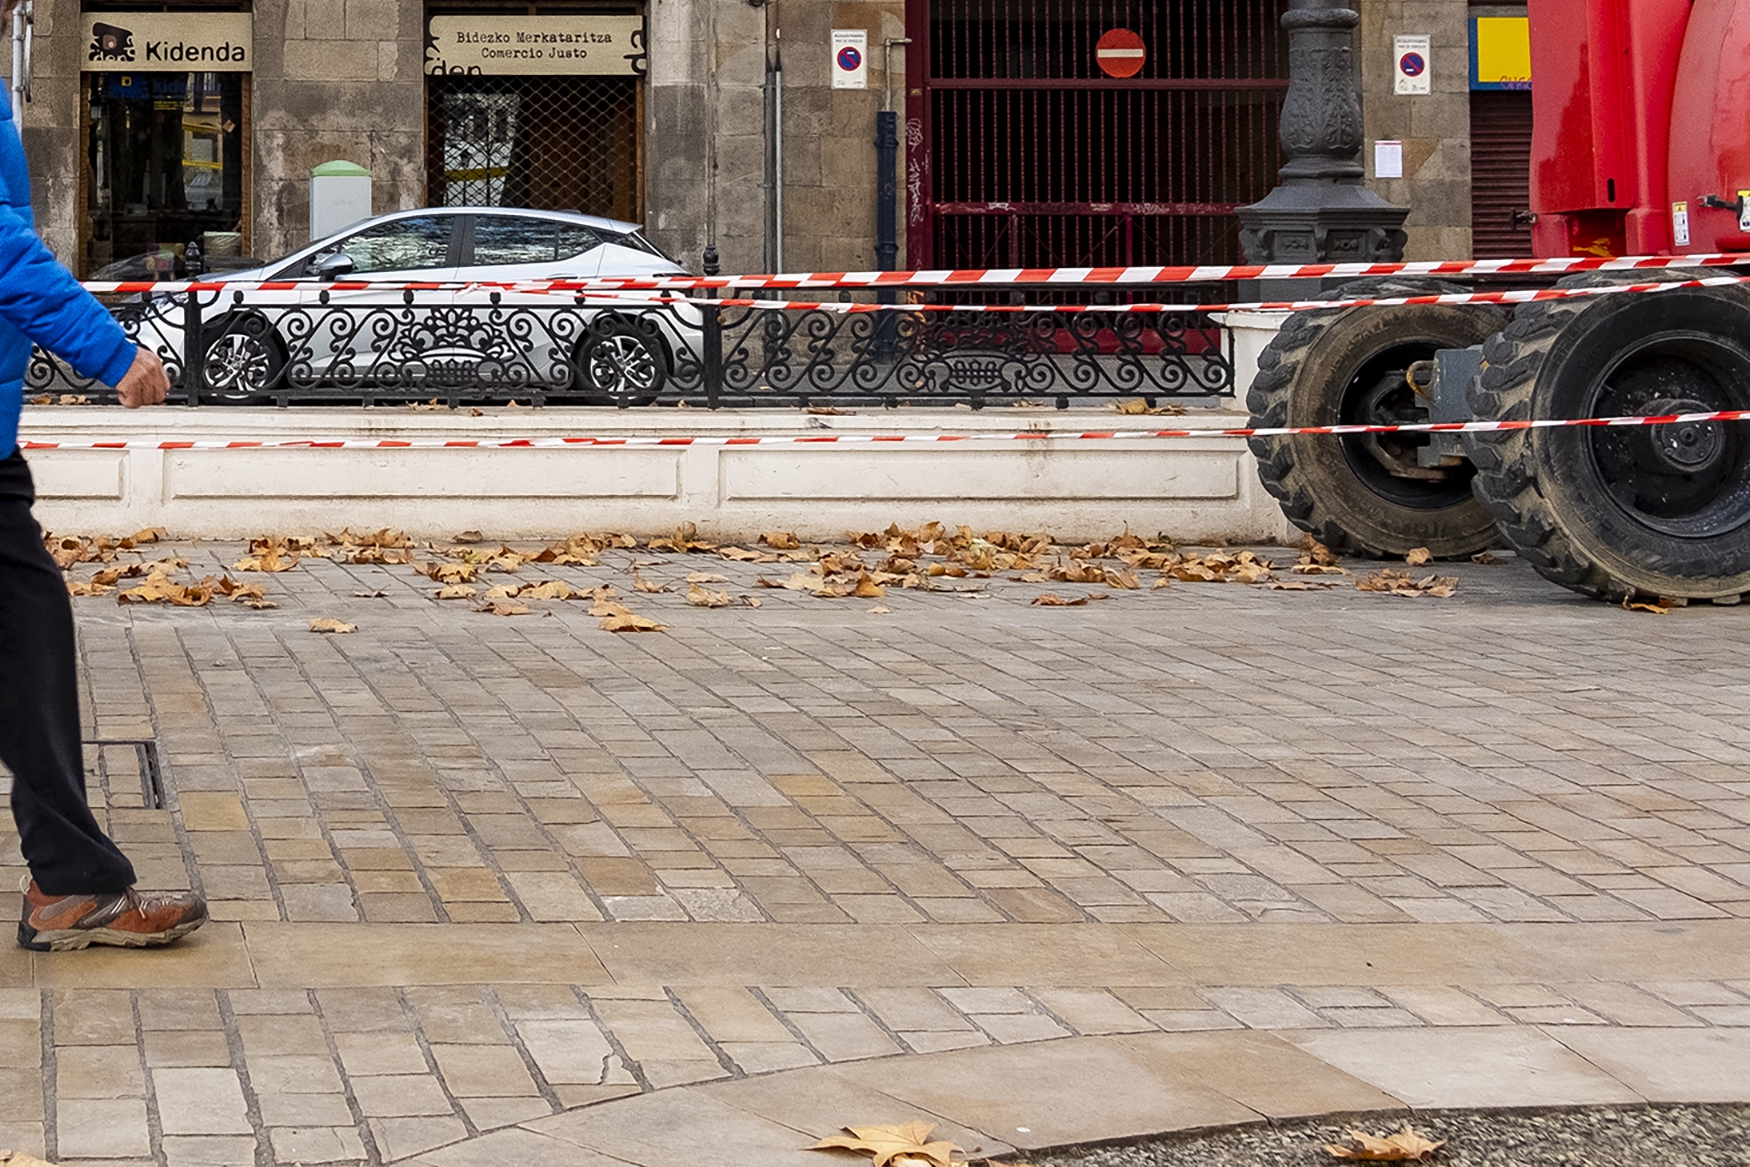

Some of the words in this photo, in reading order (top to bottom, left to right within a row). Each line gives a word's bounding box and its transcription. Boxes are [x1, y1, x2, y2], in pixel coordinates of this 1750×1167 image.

[456, 31, 510, 44] Bidezko
[516, 31, 612, 44] Merkataritza
[146, 40, 246, 62] Kidenda
[481, 46, 543, 59] Comercio
[548, 46, 588, 59] Justo
